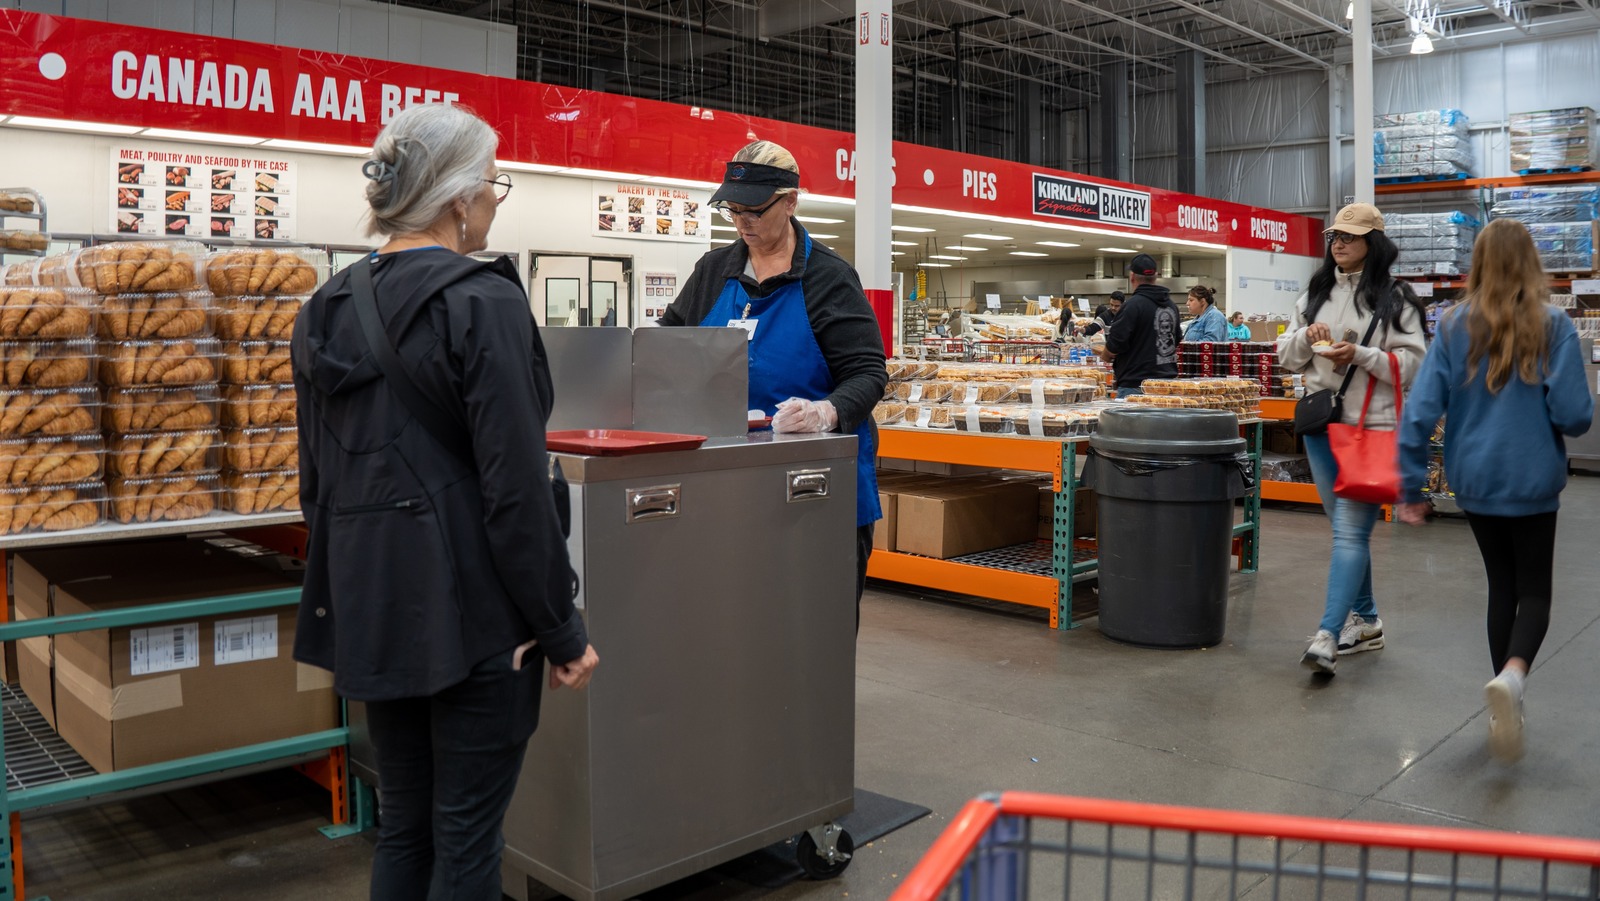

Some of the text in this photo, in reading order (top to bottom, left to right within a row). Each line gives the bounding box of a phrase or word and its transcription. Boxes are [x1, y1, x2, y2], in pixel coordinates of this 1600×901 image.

[111, 50, 275, 113] CANADA
[291, 73, 366, 123] AAA
[120, 149, 288, 172] MEAT, POULTRY AND SEAFOOD BY THE CASE
[617, 184, 689, 200] BAKERY BY THE CASE
[962, 168, 998, 201] PIES
[1038, 180, 1098, 206] KIRKLAND
[1038, 198, 1098, 215] Signature
[1103, 192, 1146, 222] BAKERY
[1177, 204, 1219, 233] COOKIES
[1250, 216, 1288, 243] PASTRIES
